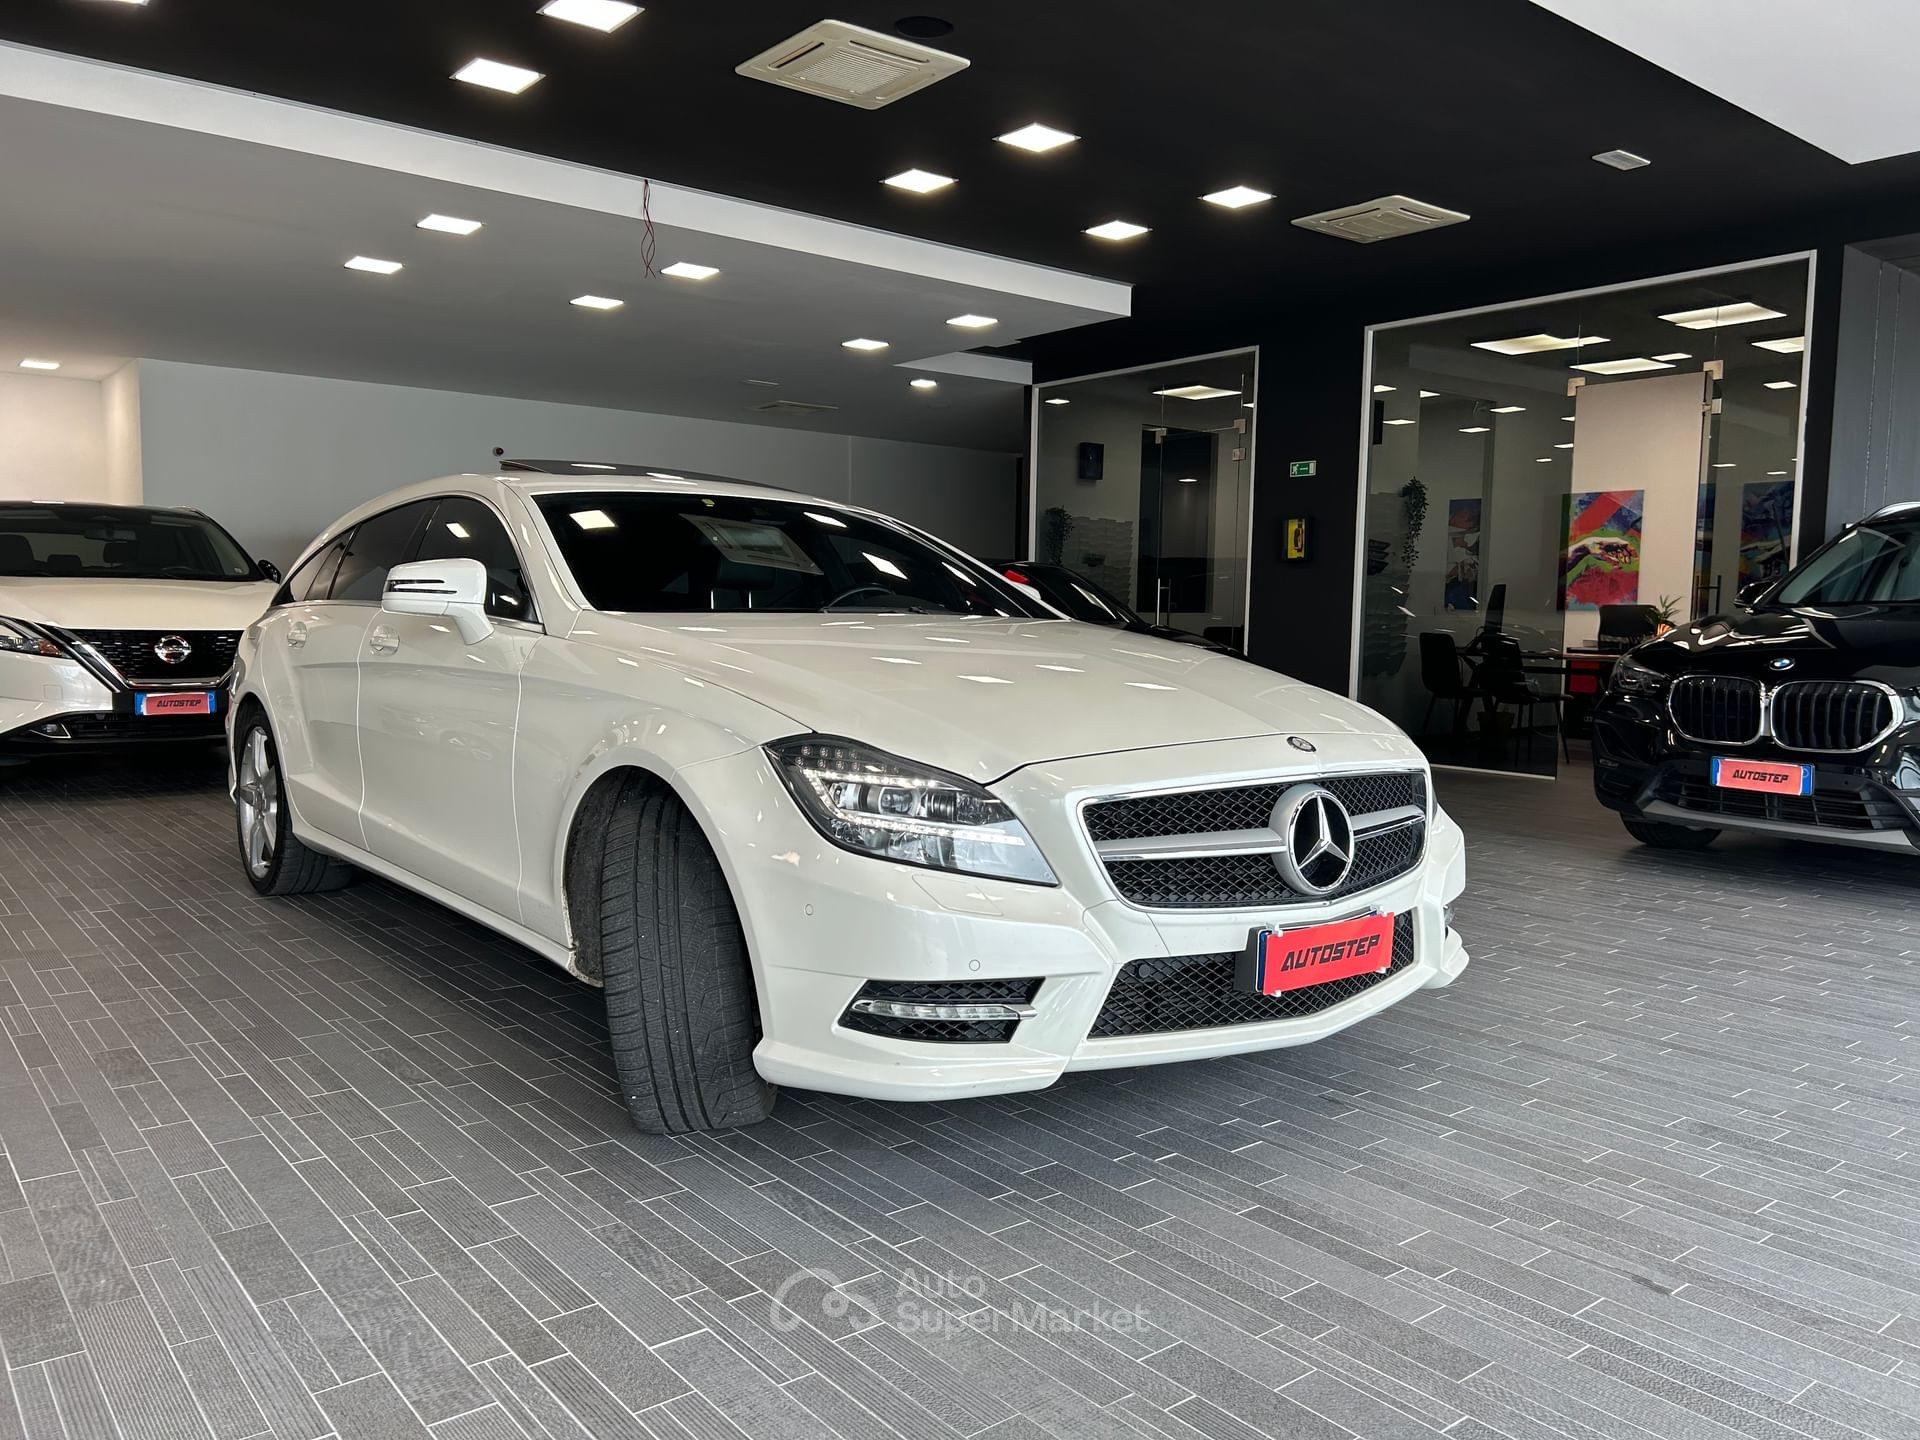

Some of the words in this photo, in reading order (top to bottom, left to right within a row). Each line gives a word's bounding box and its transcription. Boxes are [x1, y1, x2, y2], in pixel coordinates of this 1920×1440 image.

[157, 699, 201, 707] AUTOSTEP
[1732, 769, 1789, 783] AUTOSTEP
[1281, 934, 1380, 972] AUTOSTEP
